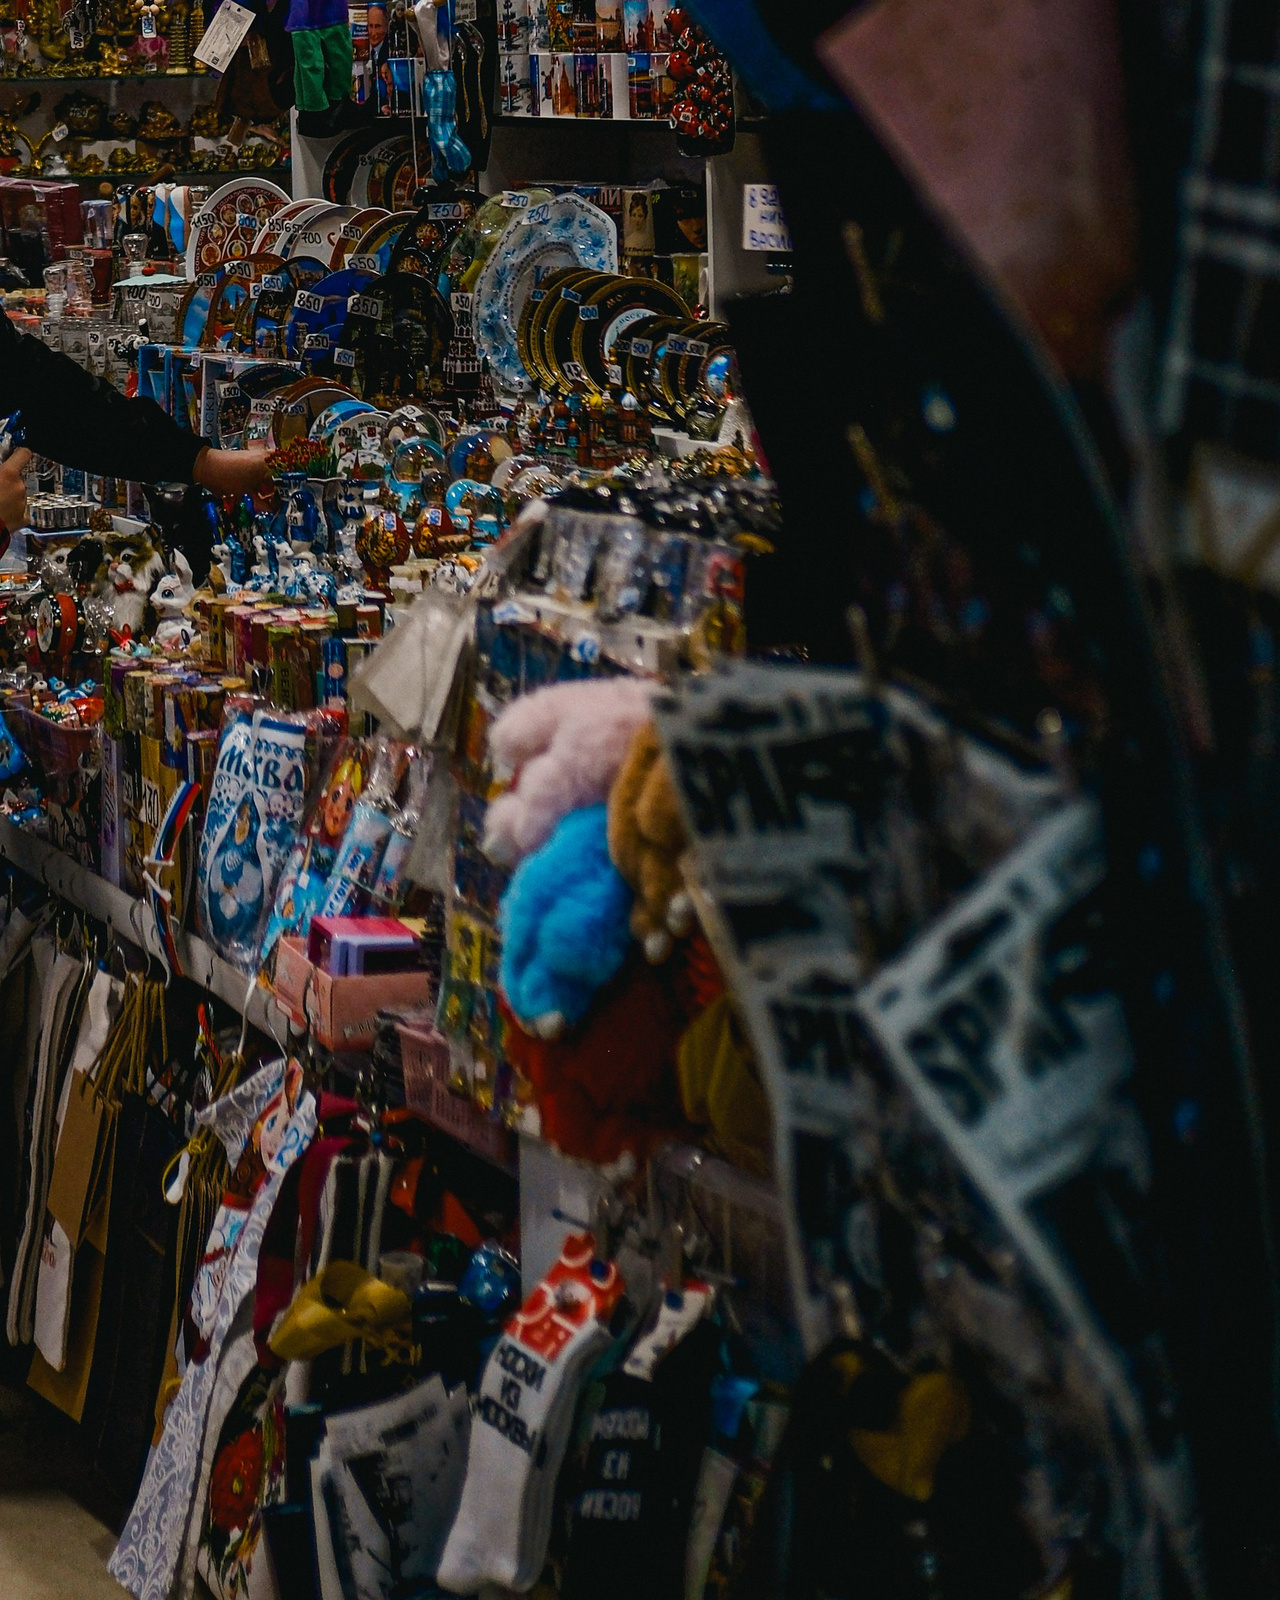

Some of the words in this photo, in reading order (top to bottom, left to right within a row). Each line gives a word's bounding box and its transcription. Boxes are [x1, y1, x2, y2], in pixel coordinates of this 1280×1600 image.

[507, 192, 529, 206] 750
[433, 204, 462, 218] 750
[238, 215, 257, 228] 800
[301, 231, 322, 245] 700
[342, 226, 362, 241] 650
[347, 256, 377, 270] 650
[229, 262, 252, 279] 850
[196, 275, 216, 287] 850
[263, 276, 283, 290] 850
[297, 294, 321, 311] 850
[351, 302, 380, 317] 850
[581, 306, 597, 319] 800
[307, 334, 329, 348] 550
[633, 342, 649, 354] 500
[205, 381, 216, 437] ОСКВА
